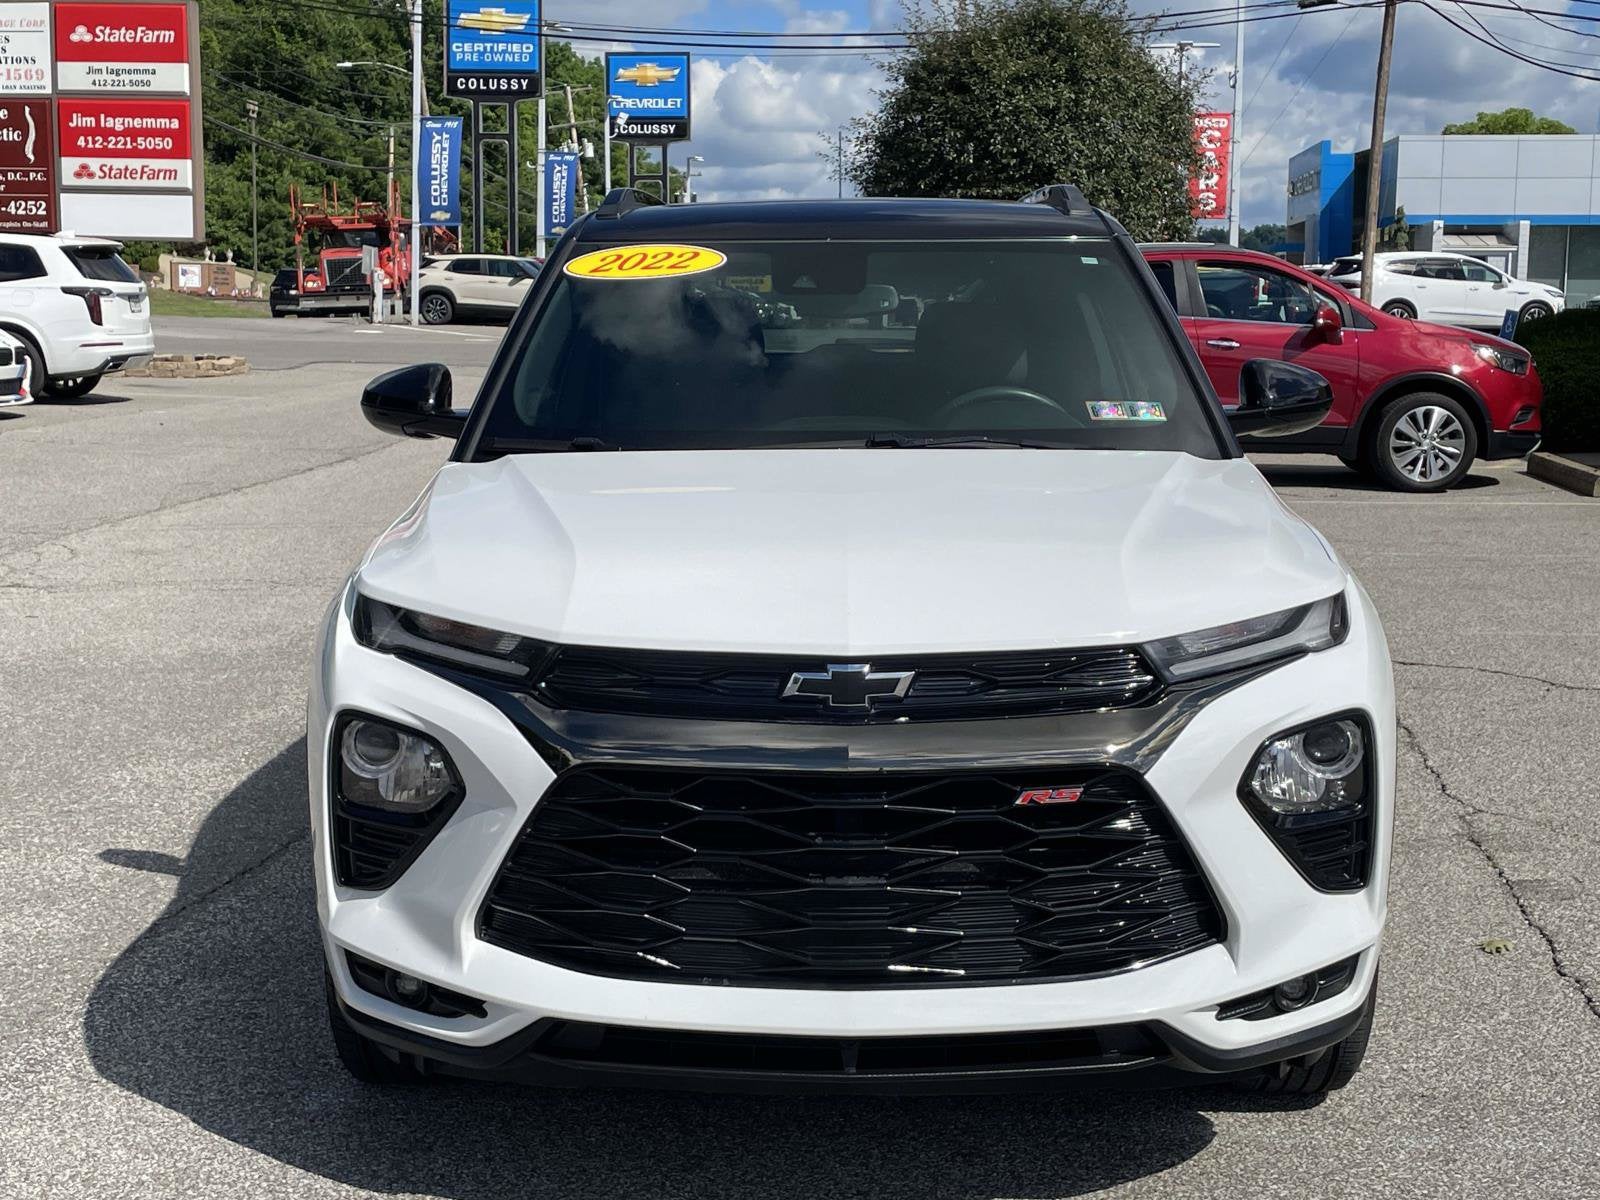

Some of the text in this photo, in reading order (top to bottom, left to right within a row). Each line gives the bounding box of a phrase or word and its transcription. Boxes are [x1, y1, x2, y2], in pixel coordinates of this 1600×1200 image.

[452, 43, 534, 52] CERTIFIED
[456, 53, 530, 62] PRE-OWNED
[86, 66, 156, 77] Jim Iagnemma
[91, 79, 151, 87] 412-221-5050
[457, 78, 529, 90] COLUSSY
[613, 98, 683, 109] CHEVROLET
[69, 113, 179, 131] Jim Iagnemma
[620, 124, 676, 134] COLUSSY
[77, 136, 173, 149] 412-221-5050
[431, 131, 441, 206] COLUSSY
[441, 131, 450, 206] CHEVROLET
[29, 172, 47, 181] P.C.
[552, 163, 561, 223] COLUSSY
[1, 201, 47, 215] -4252
[589, 251, 700, 273] 2022
[1014, 787, 1084, 805] RS
